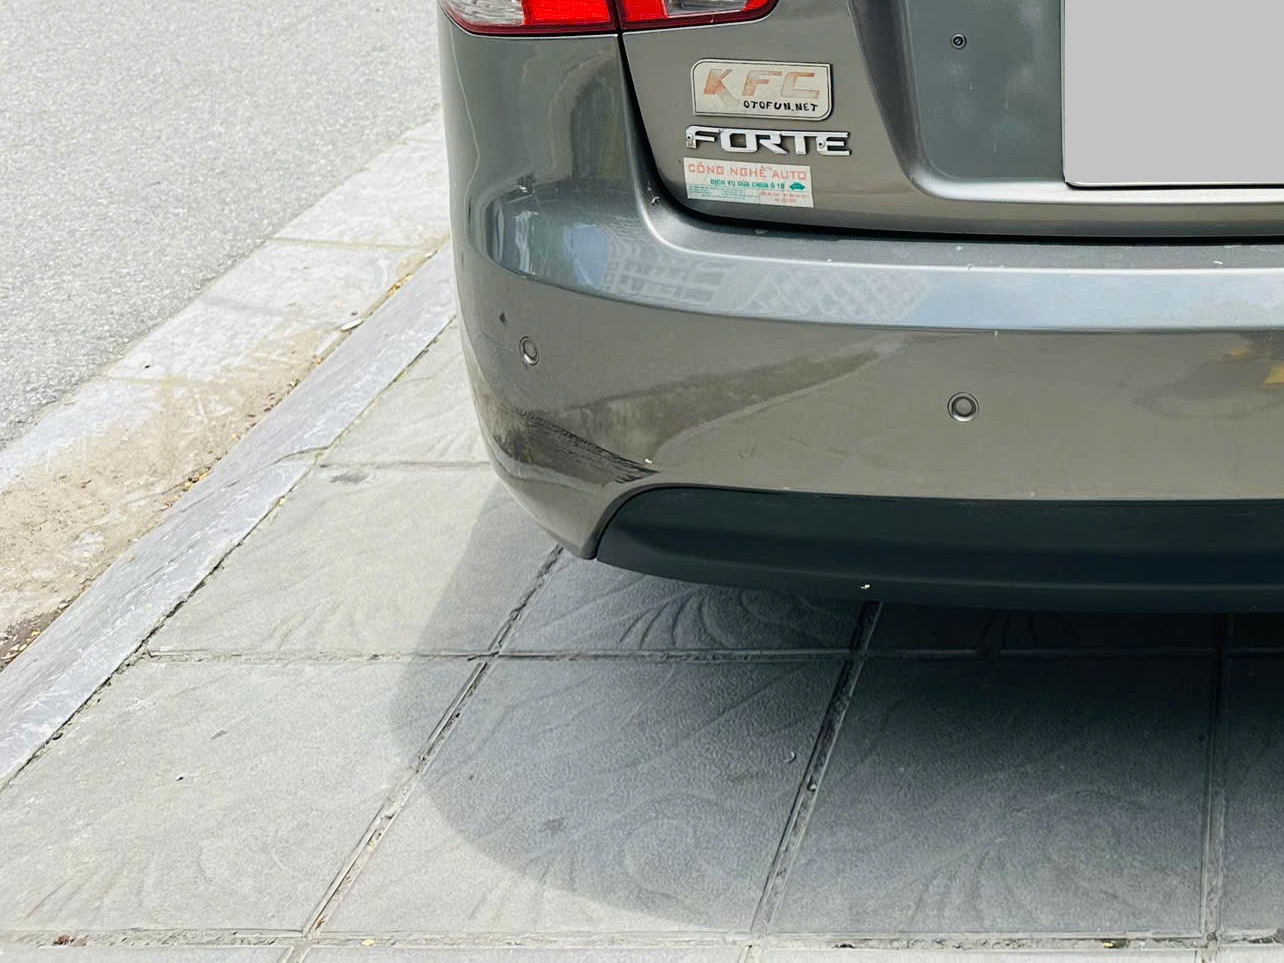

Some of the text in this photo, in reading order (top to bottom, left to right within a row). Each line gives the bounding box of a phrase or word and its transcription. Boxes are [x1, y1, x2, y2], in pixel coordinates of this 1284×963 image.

[704, 69, 820, 109] KFC
[743, 100, 819, 112] OTOFUN.NET
[686, 125, 851, 156] FORTE
[688, 162, 725, 175] CÔNG
[772, 170, 807, 180] AUTO
